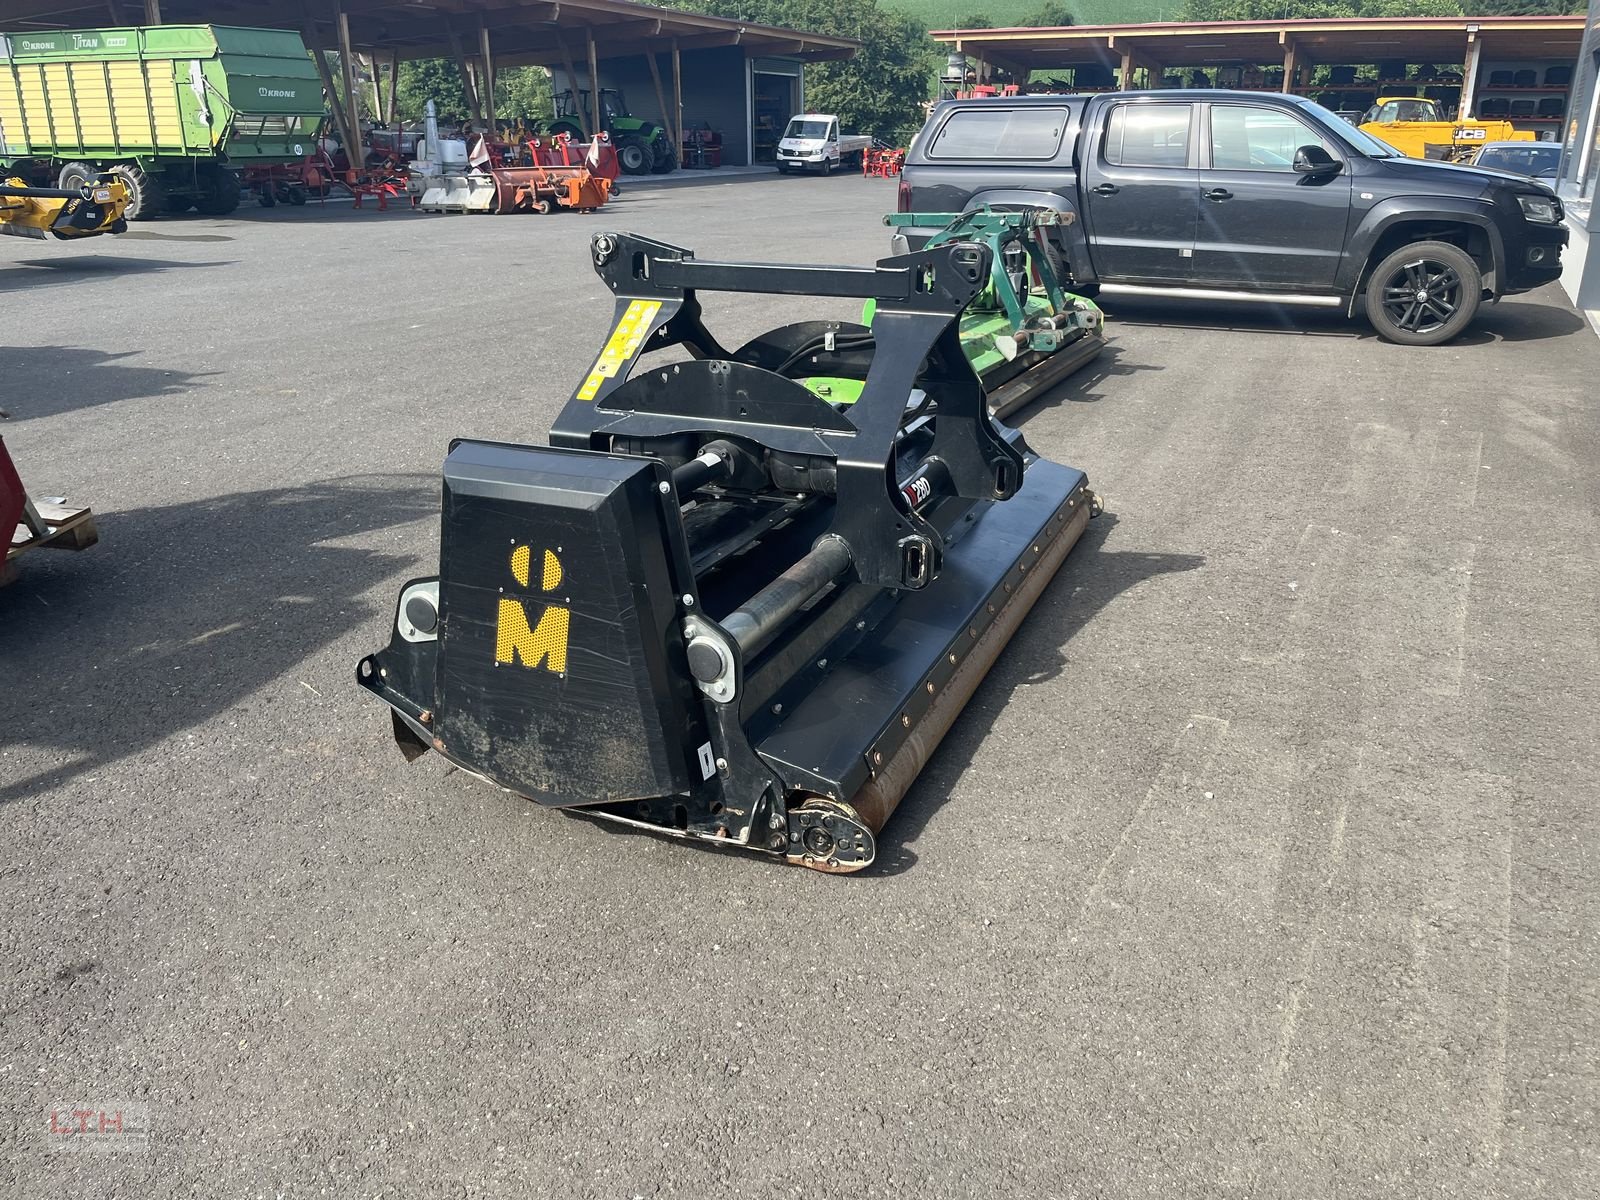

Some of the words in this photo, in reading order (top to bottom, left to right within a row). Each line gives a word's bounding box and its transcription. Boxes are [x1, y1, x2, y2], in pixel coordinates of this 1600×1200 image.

[268, 90, 296, 98] KRONE
[1453, 129, 1486, 140] JCB
[911, 476, 931, 503] 280
